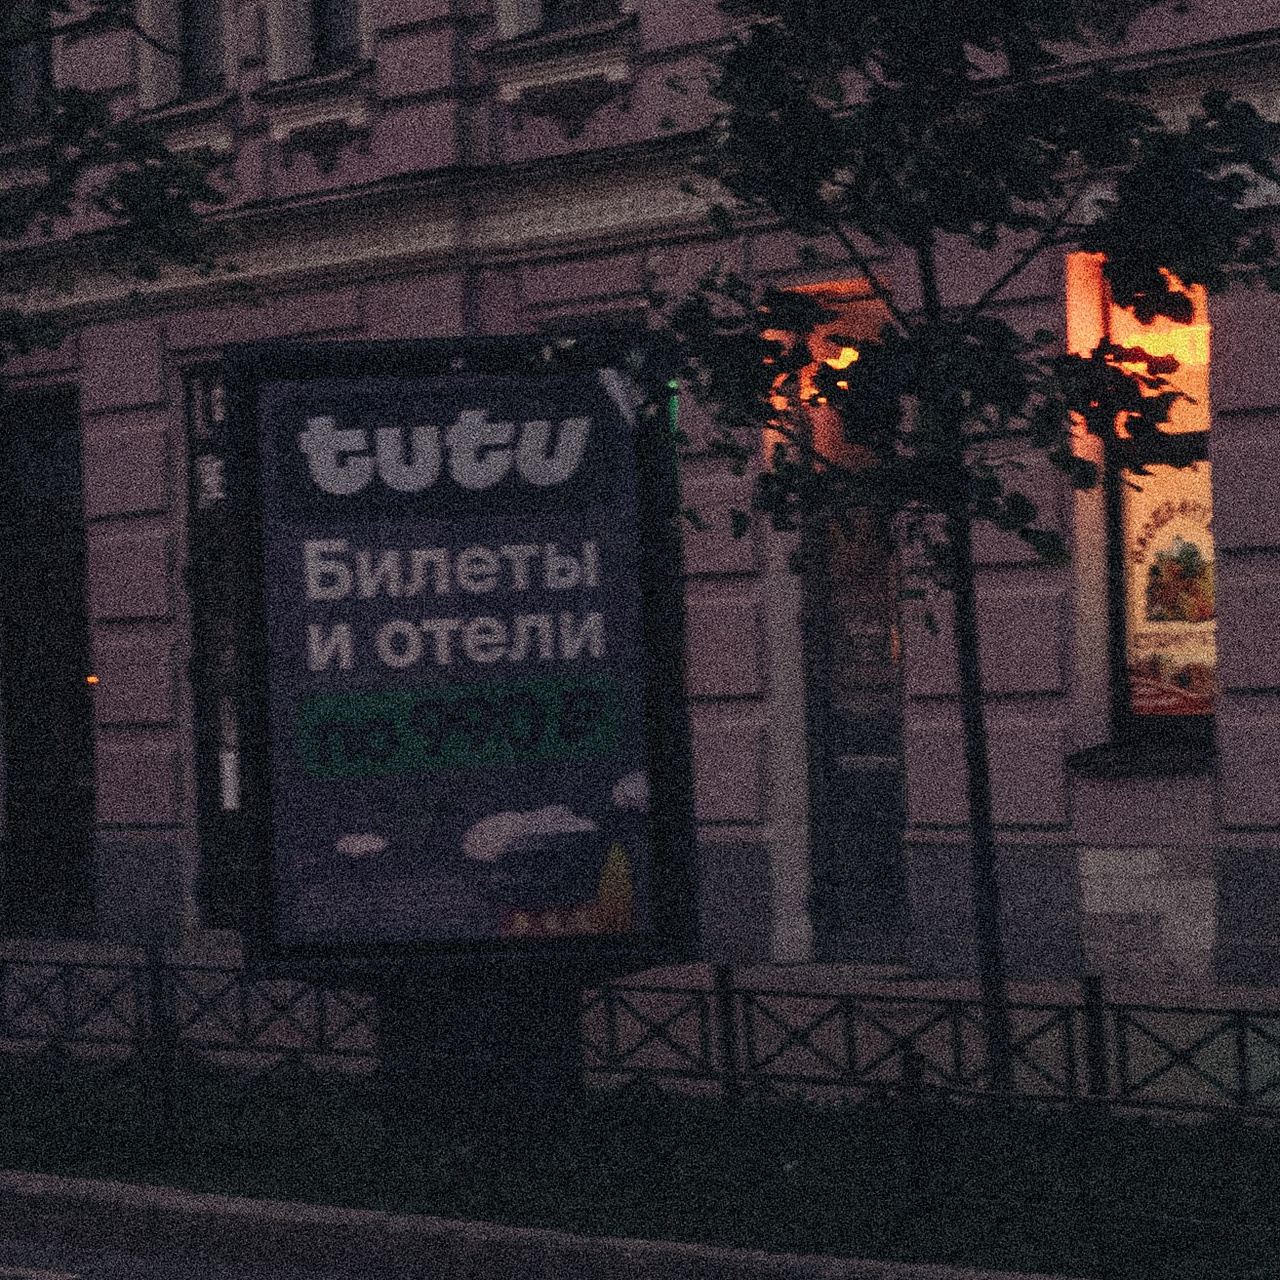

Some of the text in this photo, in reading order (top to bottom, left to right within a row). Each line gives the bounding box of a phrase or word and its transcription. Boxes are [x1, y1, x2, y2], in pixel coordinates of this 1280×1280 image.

[300, 408, 594, 496] tutu
[303, 537, 600, 601] Билеты
[307, 612, 606, 672] и отели
[313, 717, 399, 765] по
